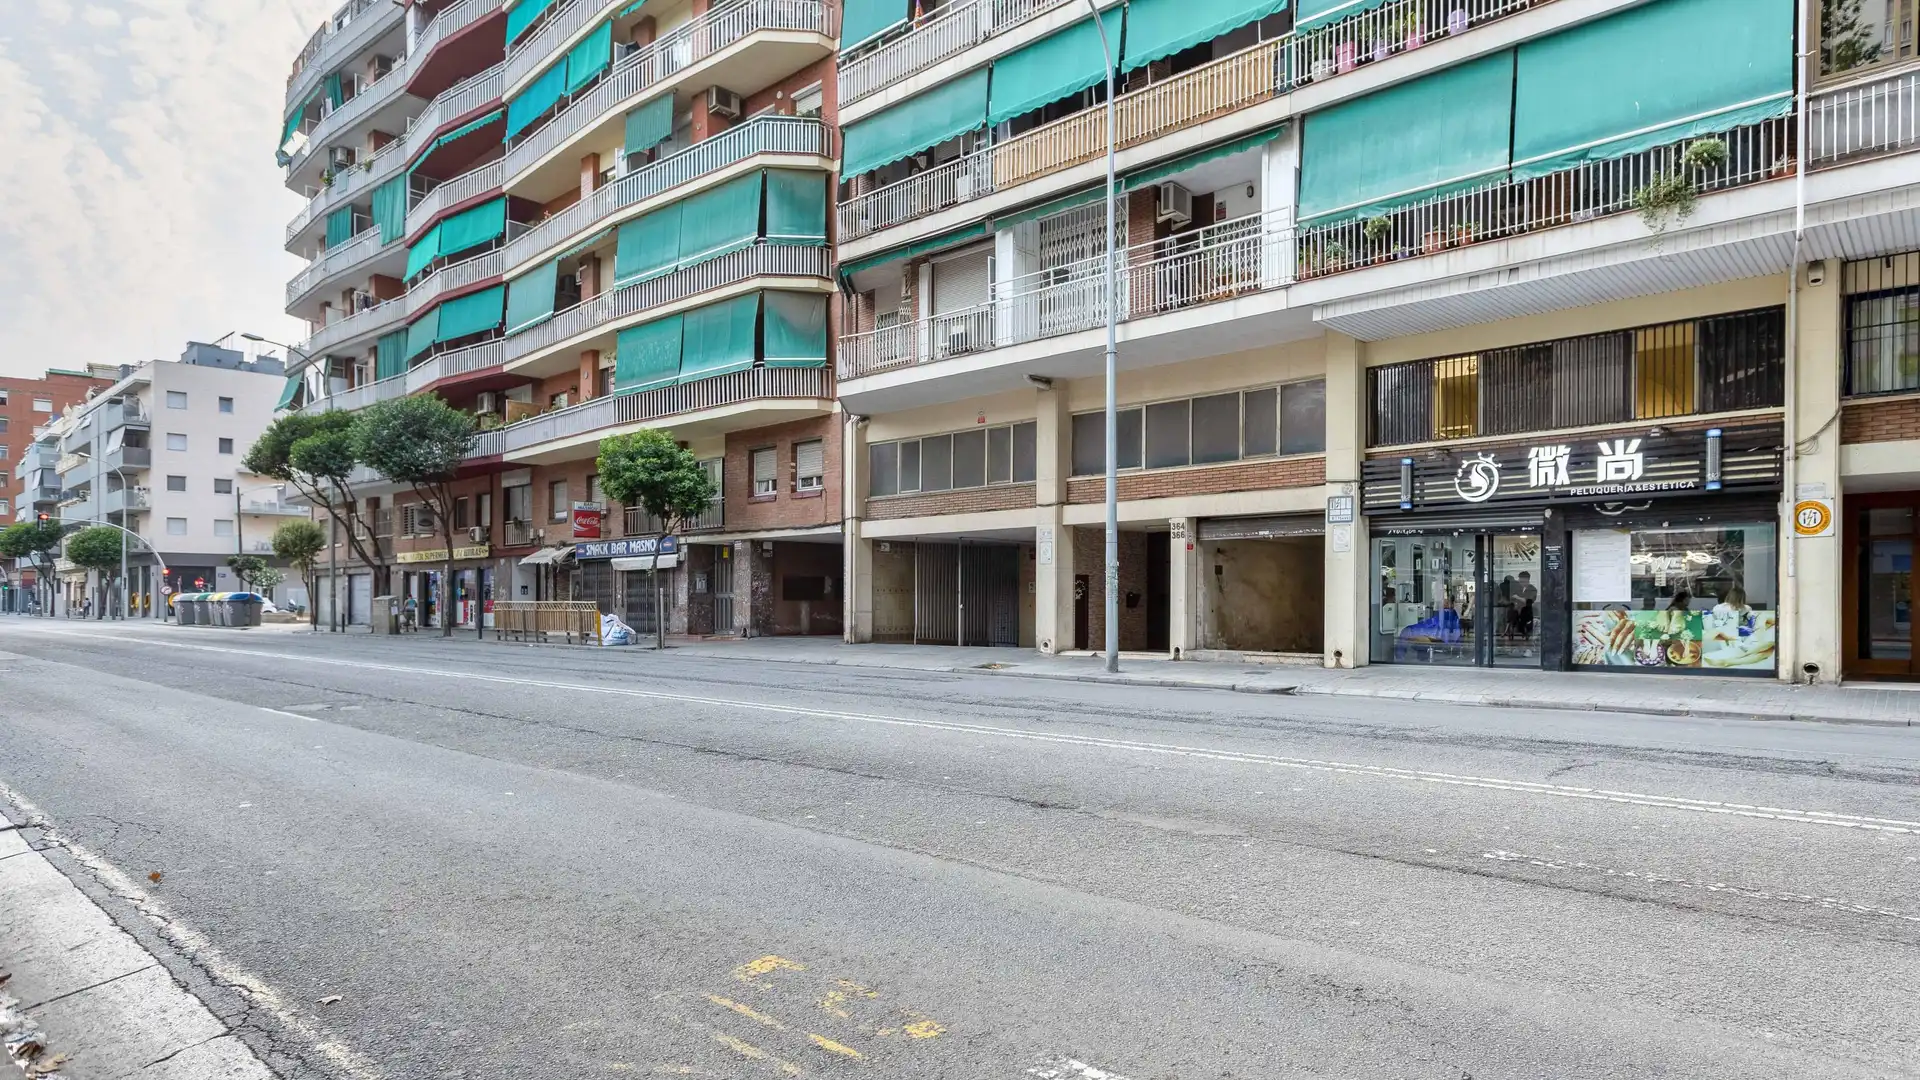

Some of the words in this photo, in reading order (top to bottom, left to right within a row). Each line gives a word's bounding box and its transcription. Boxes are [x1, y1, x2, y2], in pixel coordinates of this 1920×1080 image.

[1528, 439, 1643, 488] 微尚
[1171, 522, 1185, 530] 364
[1171, 531, 1185, 539] 366
[586, 543, 609, 556] SNACK
[611, 541, 627, 554] BAR
